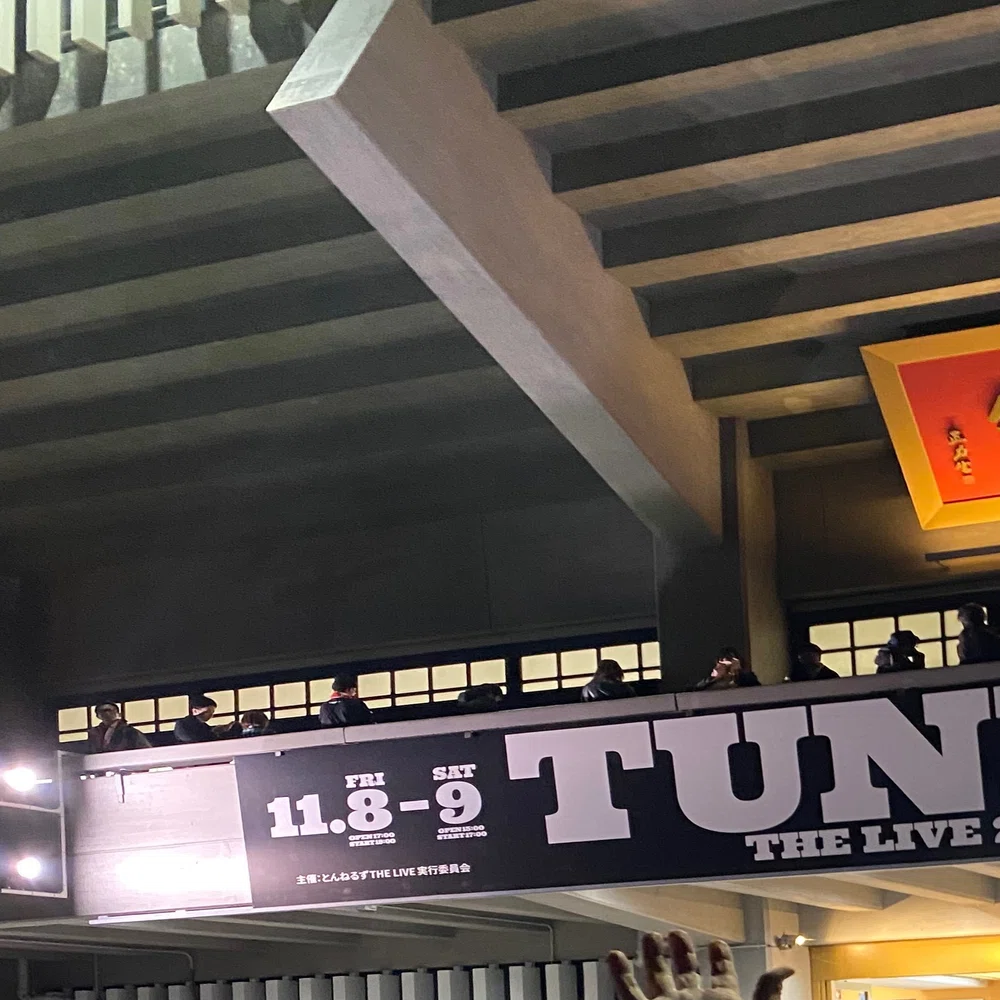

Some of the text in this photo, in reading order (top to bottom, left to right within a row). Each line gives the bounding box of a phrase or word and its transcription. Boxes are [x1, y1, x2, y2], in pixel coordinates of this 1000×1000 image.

[345, 772, 386, 789] FRI
[432, 763, 477, 781] SAT
[436, 832, 465, 840] START
[744, 827, 851, 861] THE
[861, 818, 982, 853] LIVE
[392, 867, 416, 878] LIVE
[417, 863, 471, 876] 実行委員会
